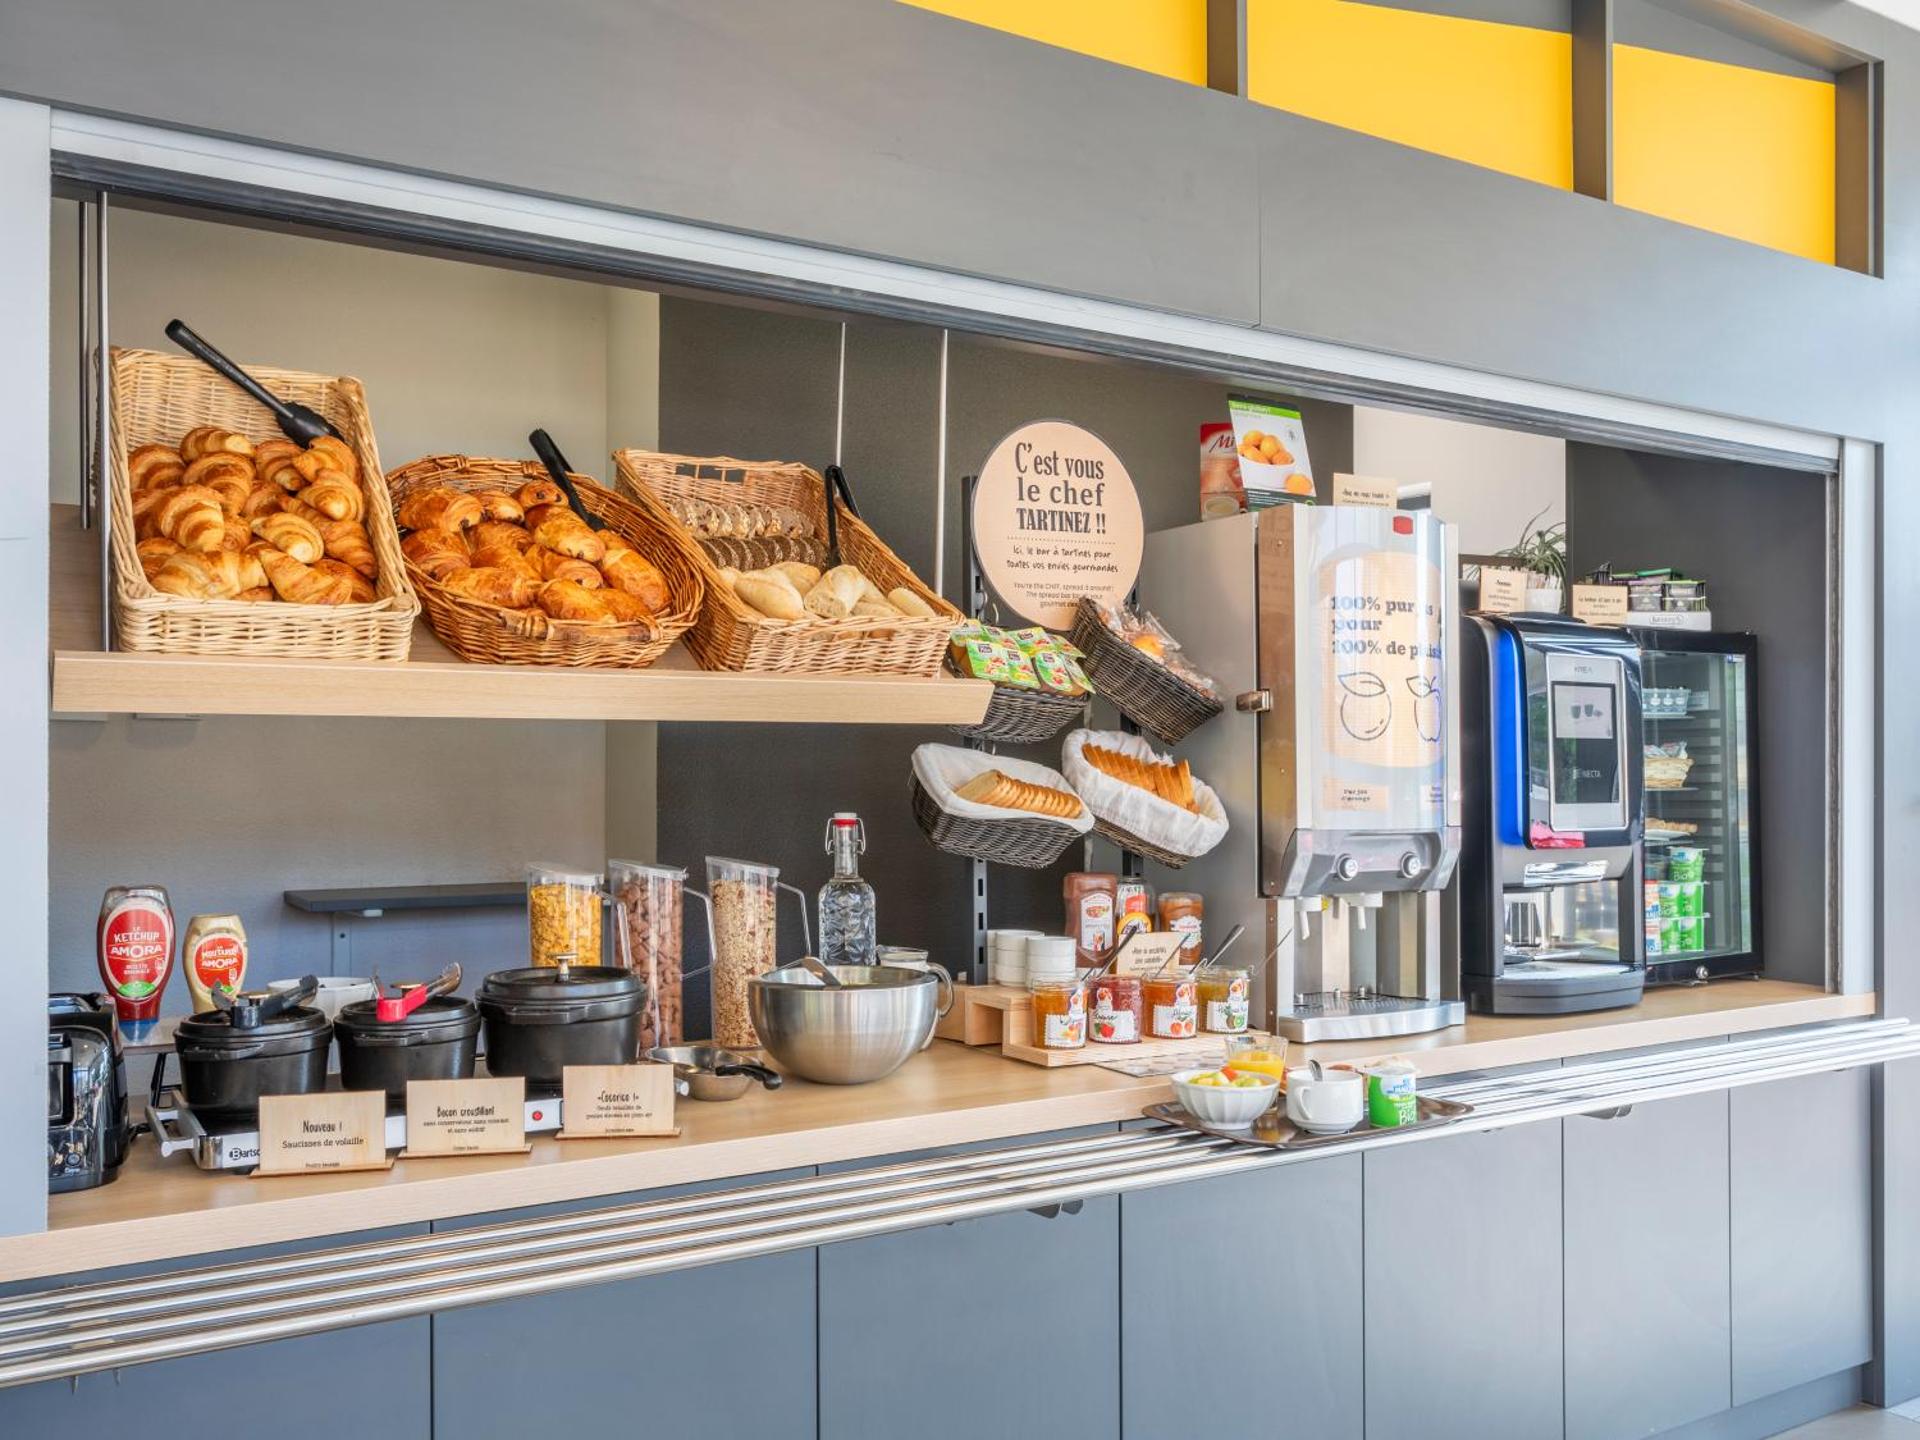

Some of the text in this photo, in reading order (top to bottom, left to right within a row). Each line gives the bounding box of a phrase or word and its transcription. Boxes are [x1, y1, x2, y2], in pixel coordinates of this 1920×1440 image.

[1015, 441, 1105, 480] C'est vous
[1017, 476, 1106, 507] le chef
[1016, 507, 1106, 535] TARTINEZ !!
[1036, 546, 1050, 557] bar
[1093, 551, 1112, 561] pour
[1032, 561, 1046, 570] vos
[1048, 560, 1071, 572] envies
[1072, 562, 1118, 574] gourmandes
[1330, 595, 1381, 611] 100%
[1385, 599, 1416, 616] pur
[1331, 618, 1383, 635] pour
[1331, 639, 1383, 655] 100%
[1386, 640, 1407, 656] de
[114, 932, 160, 943] KETCHUP
[111, 944, 163, 958] AMORA
[202, 957, 239, 969] AMORA
[436, 1105, 458, 1118] Bacon
[1399, 1109, 1416, 1126] Bio
[302, 1119, 336, 1133] Nouveau
[282, 1136, 364, 1149] Saucisses de volaille
